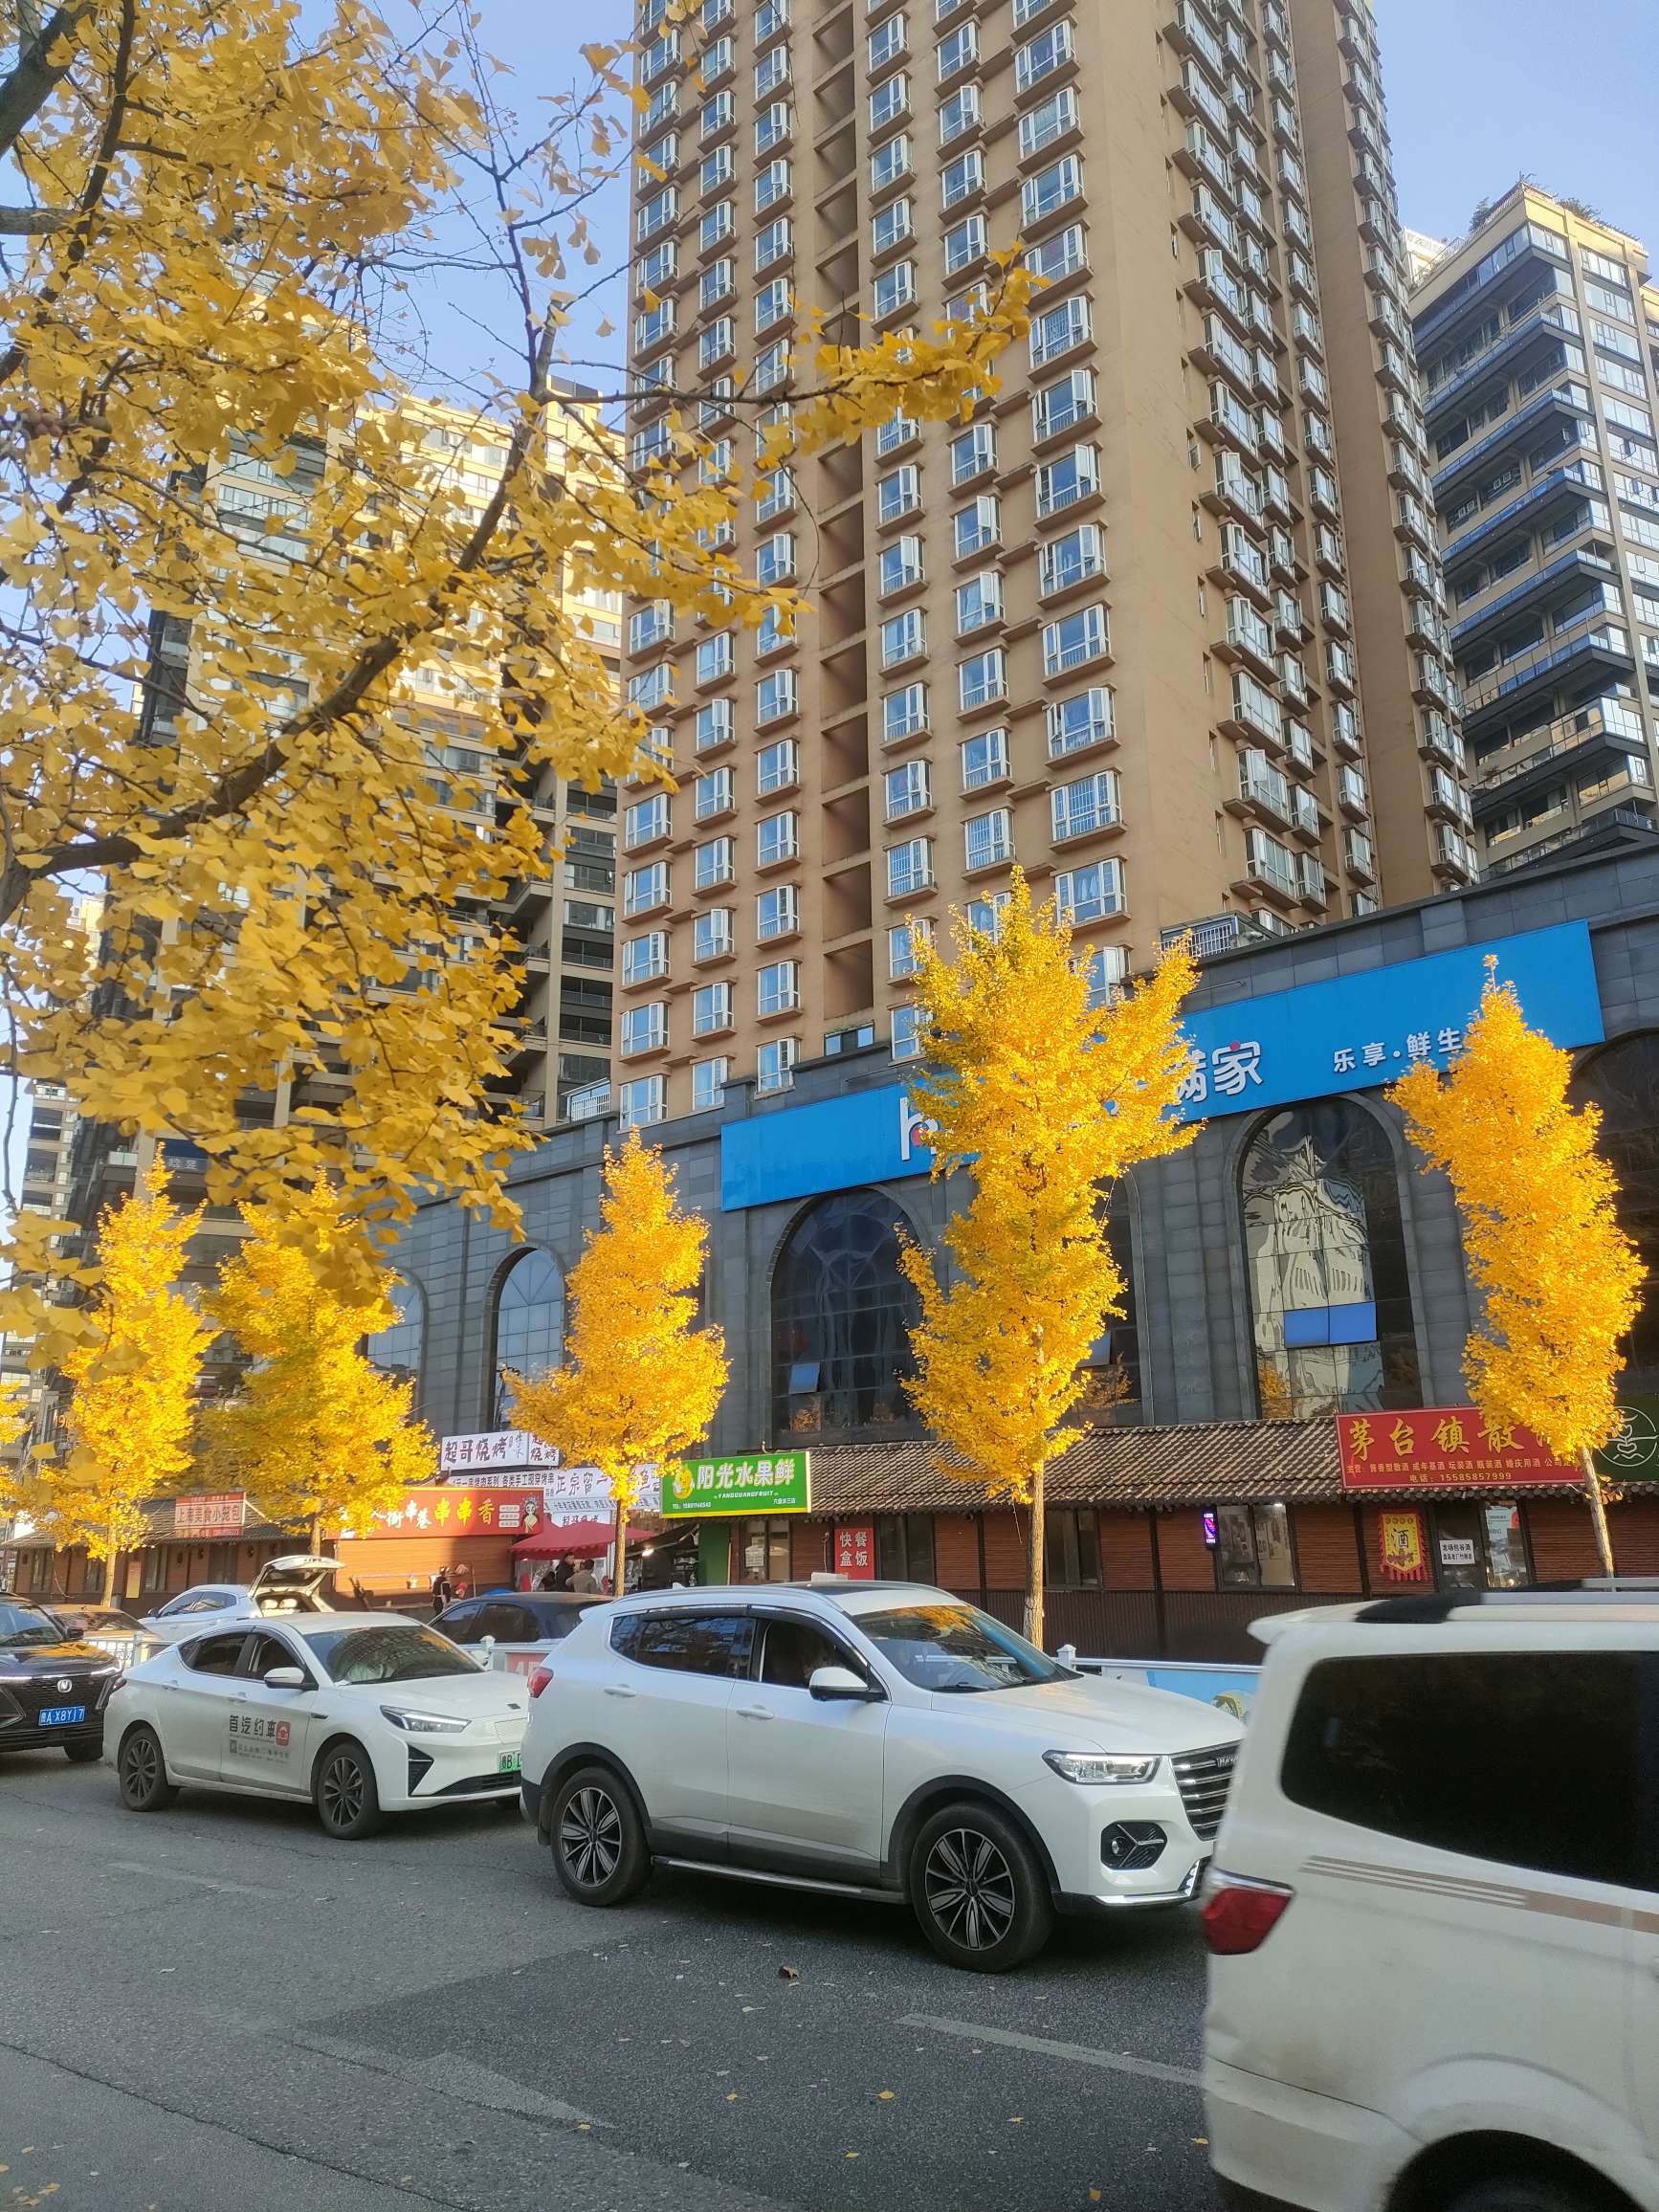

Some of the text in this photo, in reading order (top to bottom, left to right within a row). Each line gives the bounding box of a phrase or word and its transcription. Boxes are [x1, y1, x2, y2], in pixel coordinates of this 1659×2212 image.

[1349, 1416, 1544, 1462] 茅台镇散
[697, 1457, 796, 1491] 阳光水果鲜
[839, 1531, 868, 1548] 快餐
[1390, 1528, 1409, 1549] 酒
[839, 1550, 869, 1567] 盒饭
